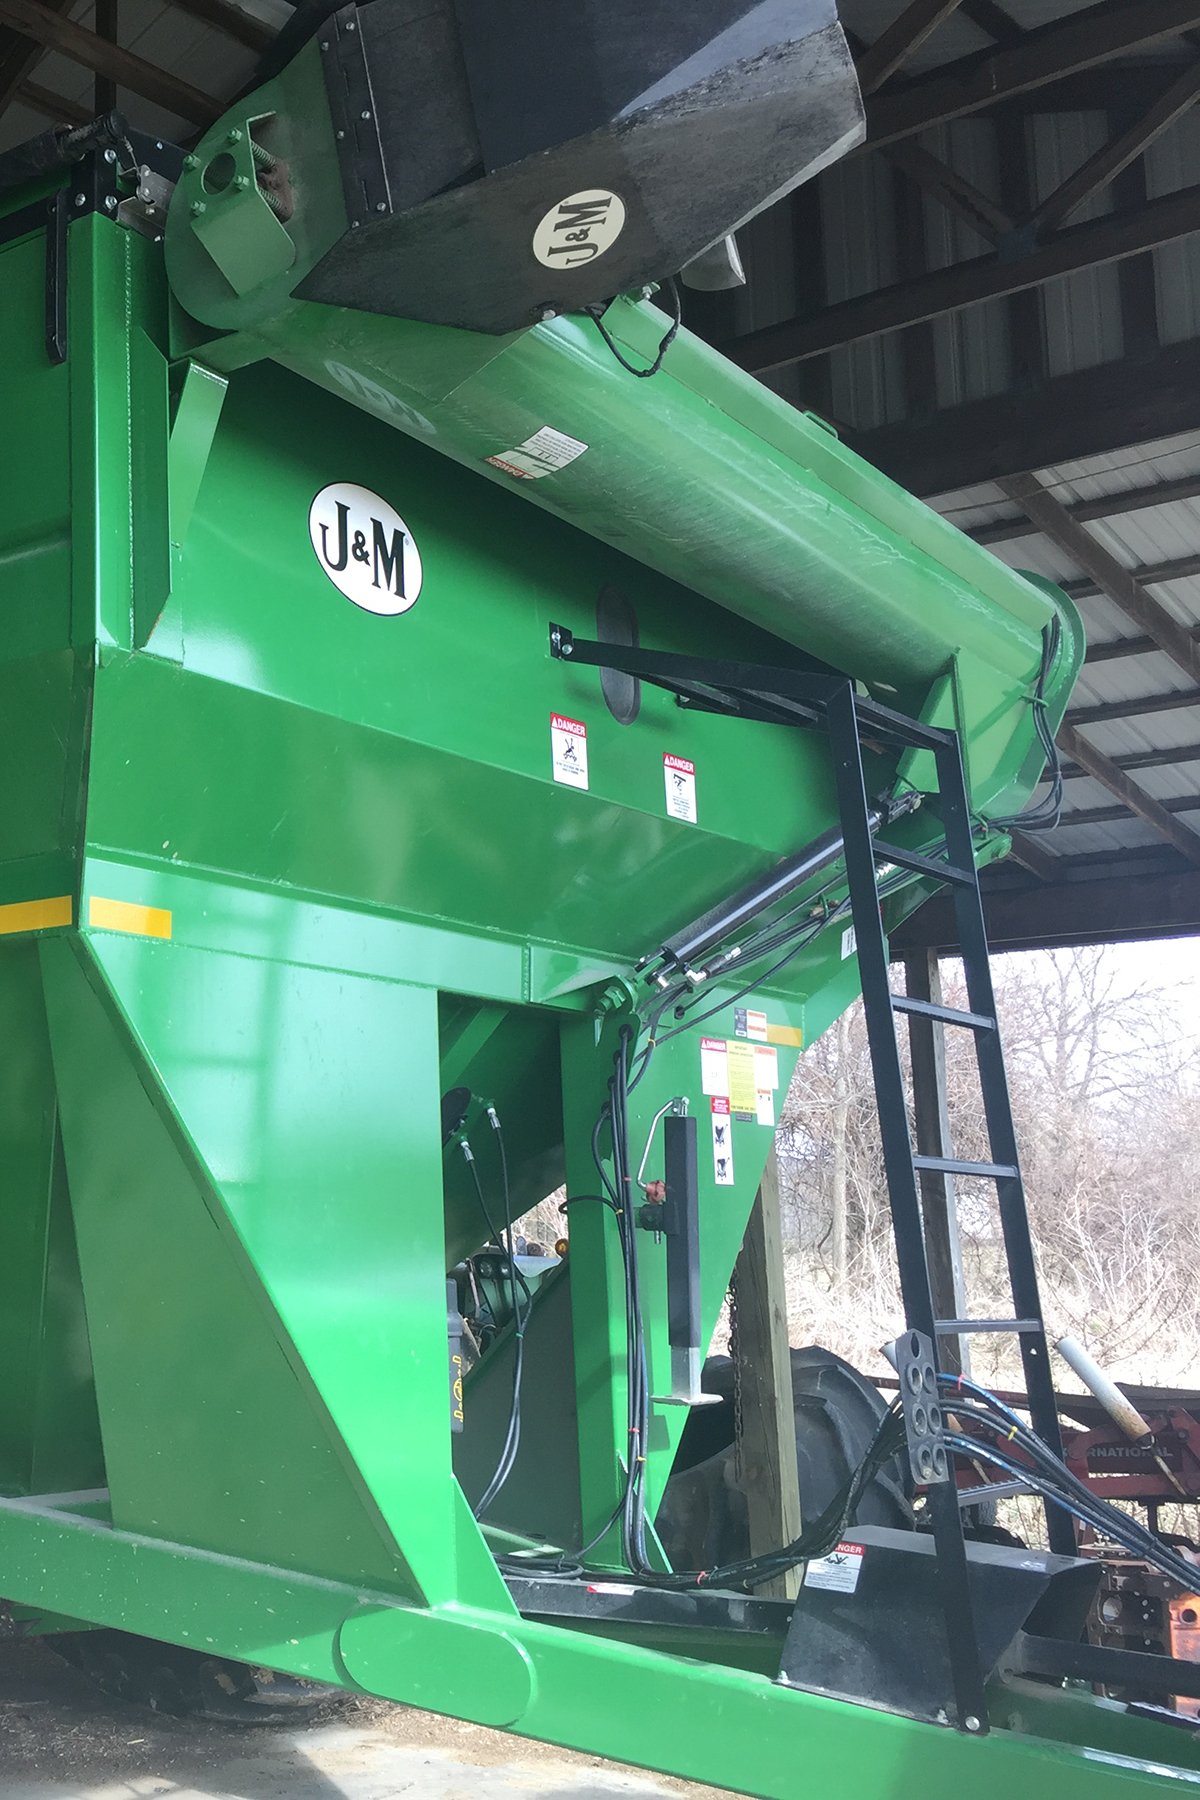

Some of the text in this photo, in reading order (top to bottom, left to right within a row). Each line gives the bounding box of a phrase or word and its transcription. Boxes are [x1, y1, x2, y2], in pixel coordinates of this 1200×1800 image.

[546, 196, 613, 265] J&M
[318, 500, 407, 600] J&M
[557, 718, 586, 736] DANGER
[669, 756, 694, 773] DANGER
[836, 1543, 863, 1554] NGER
